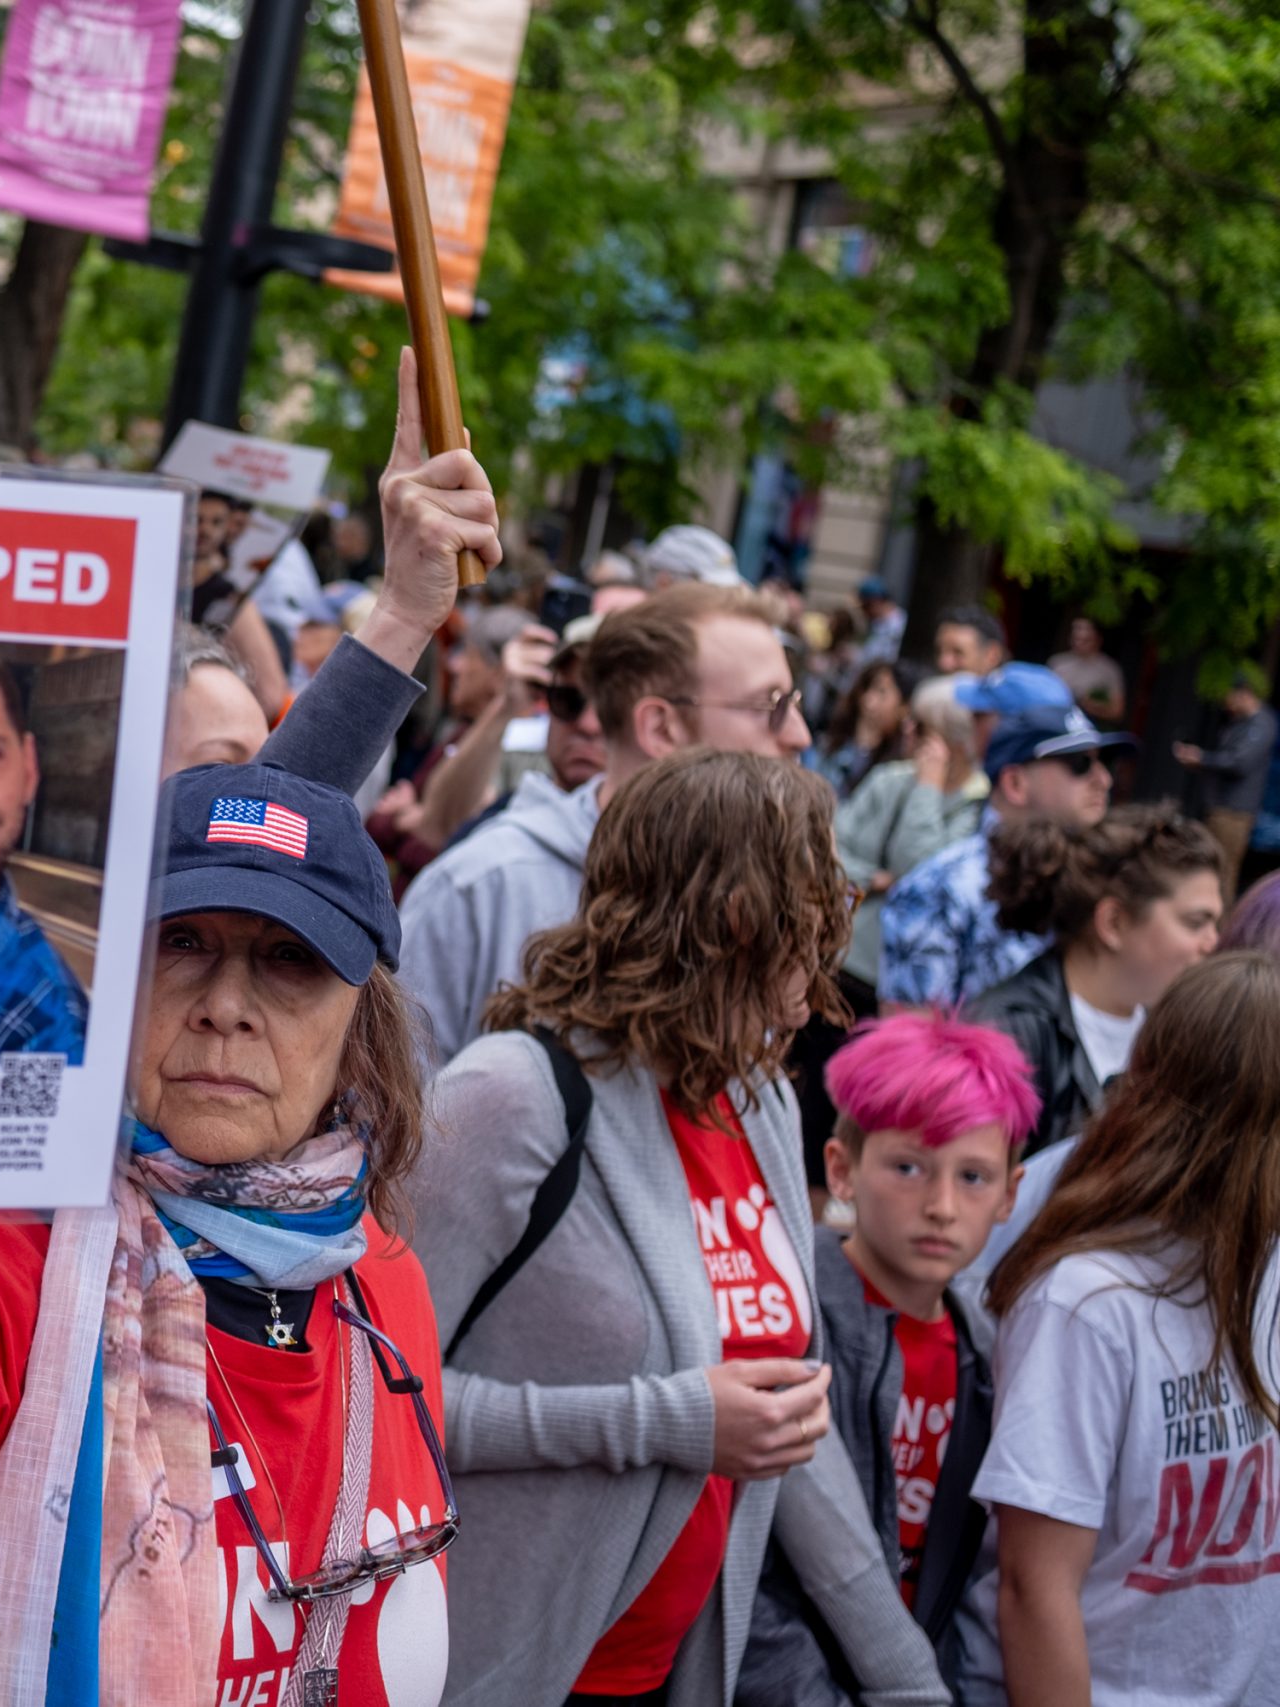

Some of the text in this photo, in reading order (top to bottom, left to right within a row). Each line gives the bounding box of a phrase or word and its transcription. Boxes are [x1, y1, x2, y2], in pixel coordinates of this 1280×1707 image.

[704, 1248, 758, 1282] HEIR
[1160, 1367, 1230, 1419] BRING
[1164, 1410, 1230, 1461] THEM
